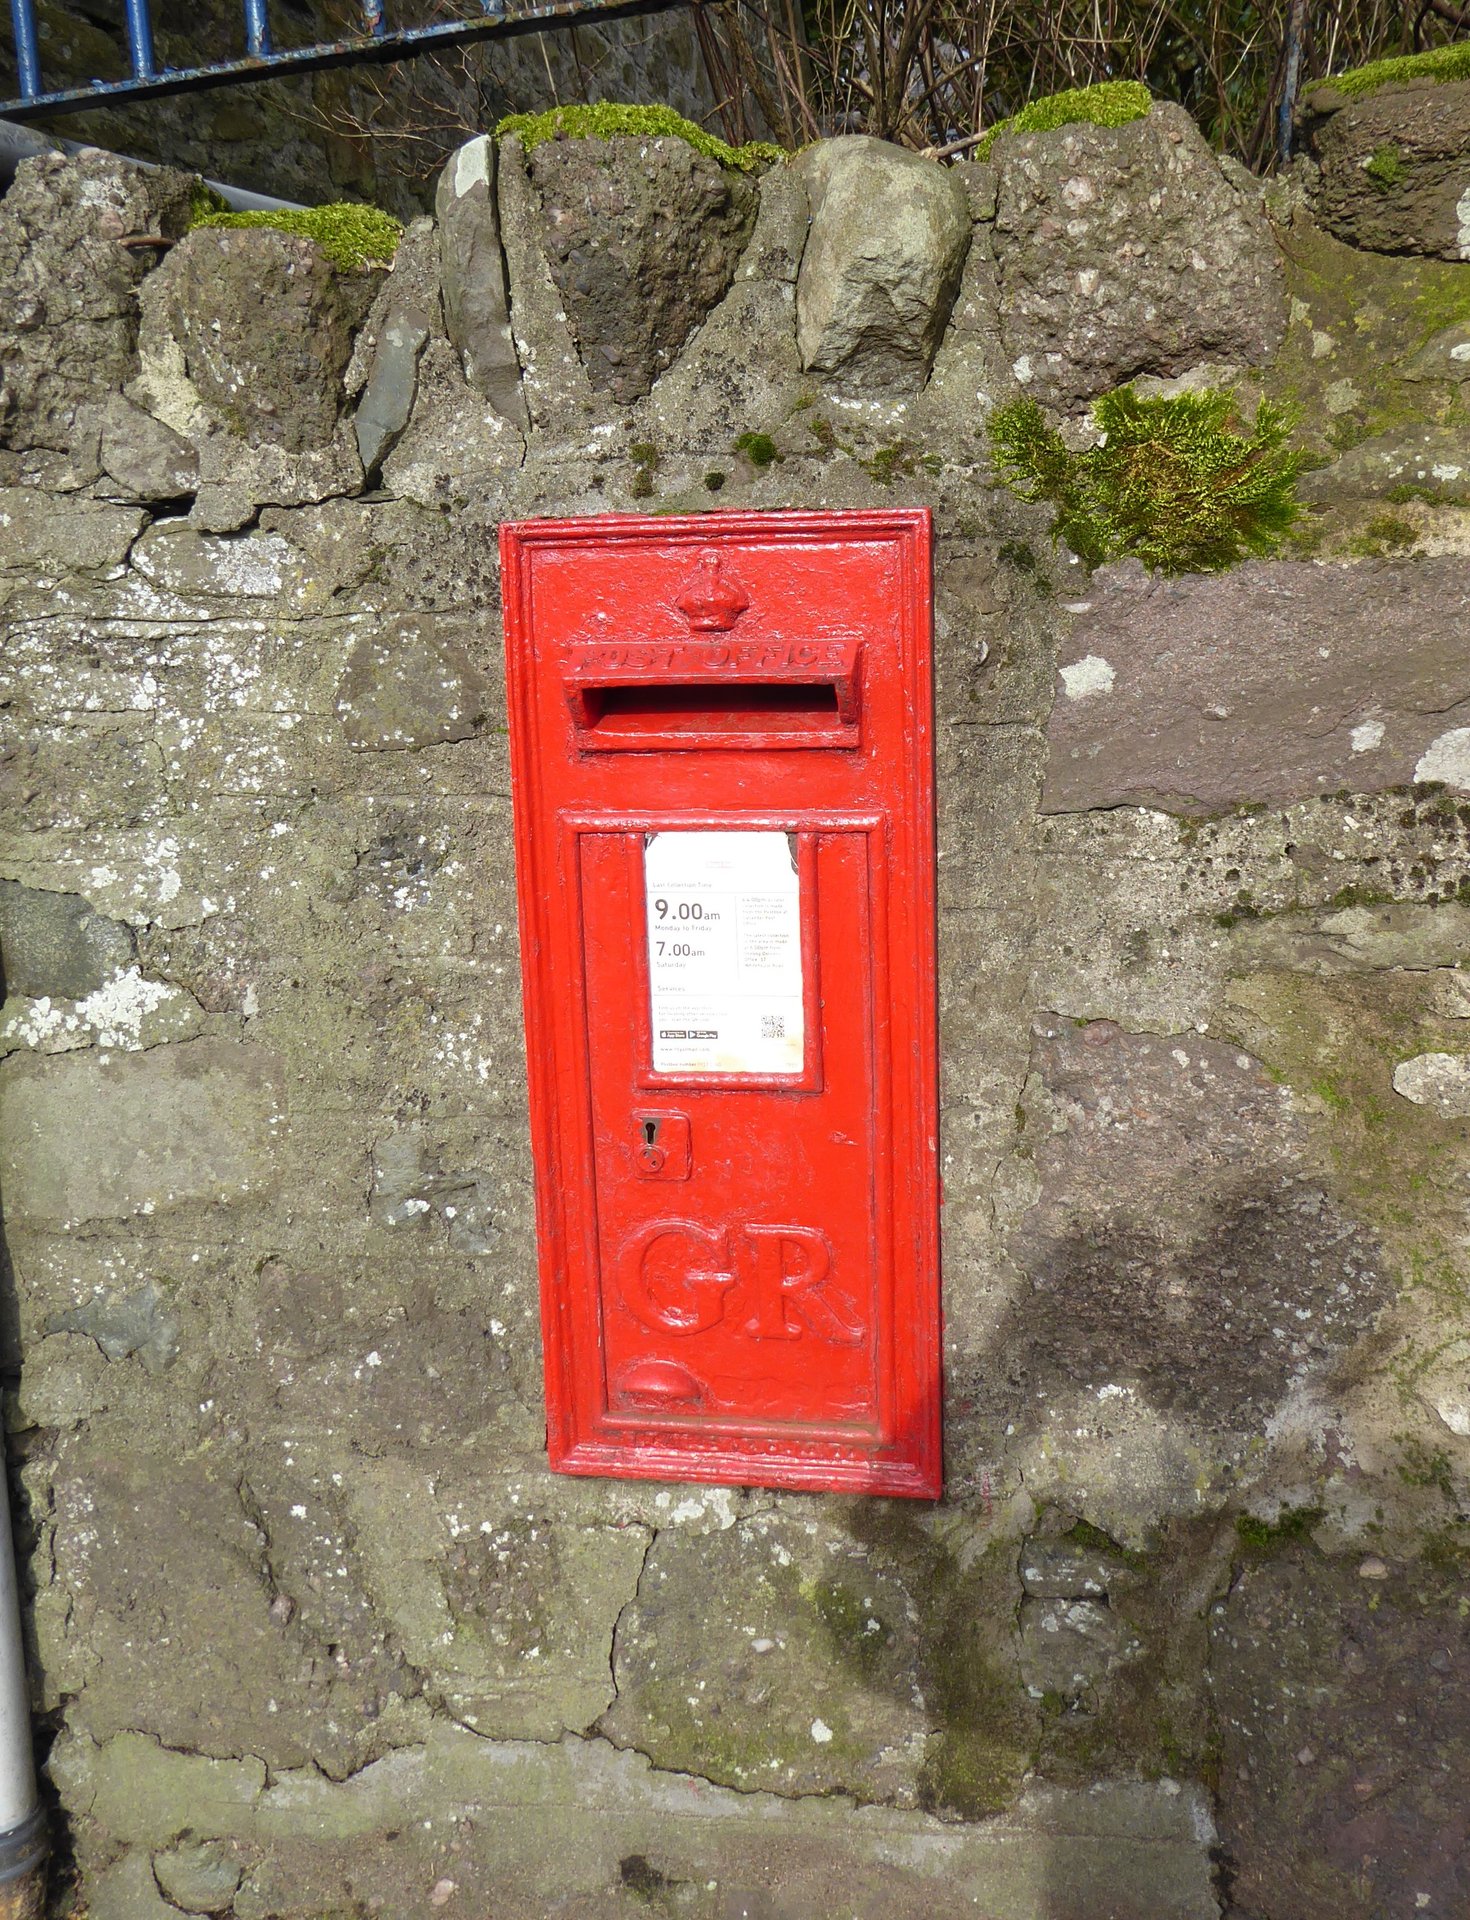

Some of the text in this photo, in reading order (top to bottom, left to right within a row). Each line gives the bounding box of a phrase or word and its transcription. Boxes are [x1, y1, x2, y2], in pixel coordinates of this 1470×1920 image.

[573, 644, 847, 671] POST OFFICE
[654, 898, 721, 921] 9.00am
[655, 924, 680, 932] Monday
[691, 924, 712, 932] Friday
[656, 941, 705, 957] 7.00am
[656, 961, 686, 969] Saturday
[617, 1217, 867, 1345] GR
